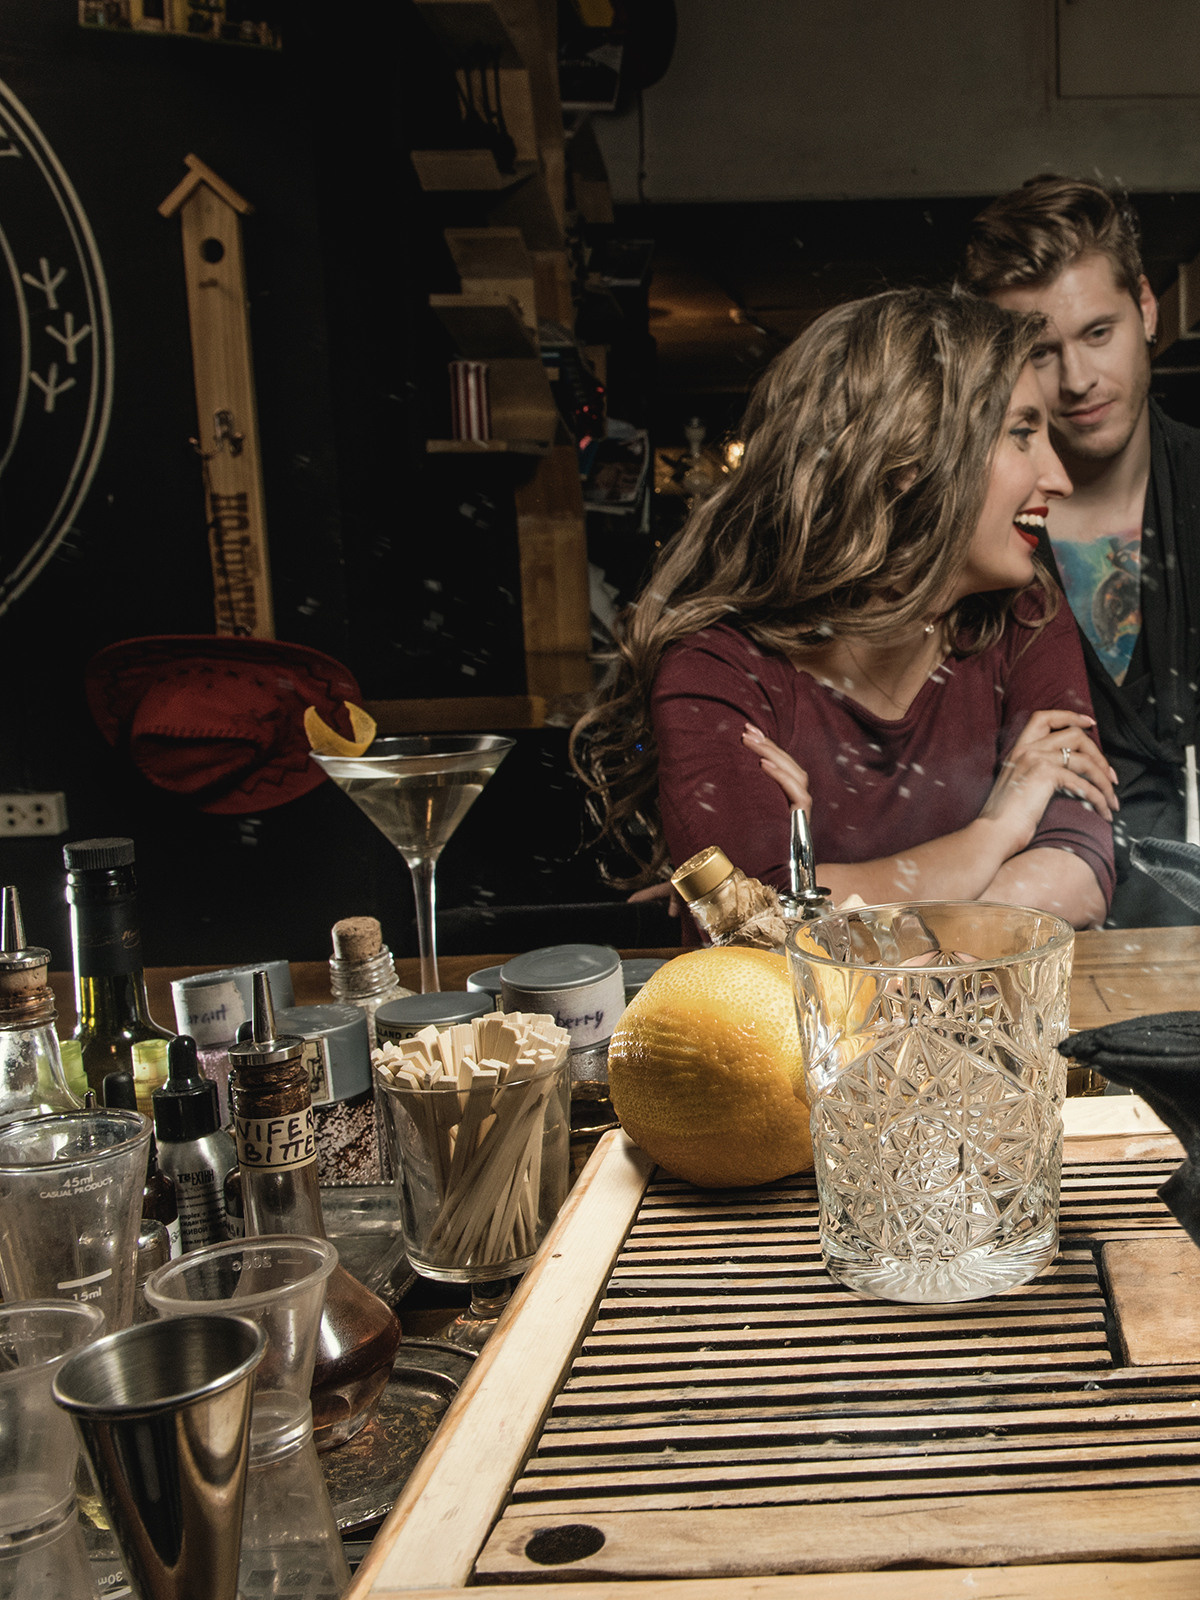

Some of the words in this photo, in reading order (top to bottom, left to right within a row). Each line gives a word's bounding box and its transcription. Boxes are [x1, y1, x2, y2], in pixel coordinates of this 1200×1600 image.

[40, 1189, 73, 1199] CASUAL
[74, 1176, 113, 1195] PRODUCT
[63, 1174, 94, 1188] 45ml
[73, 1286, 102, 1301] 15ml
